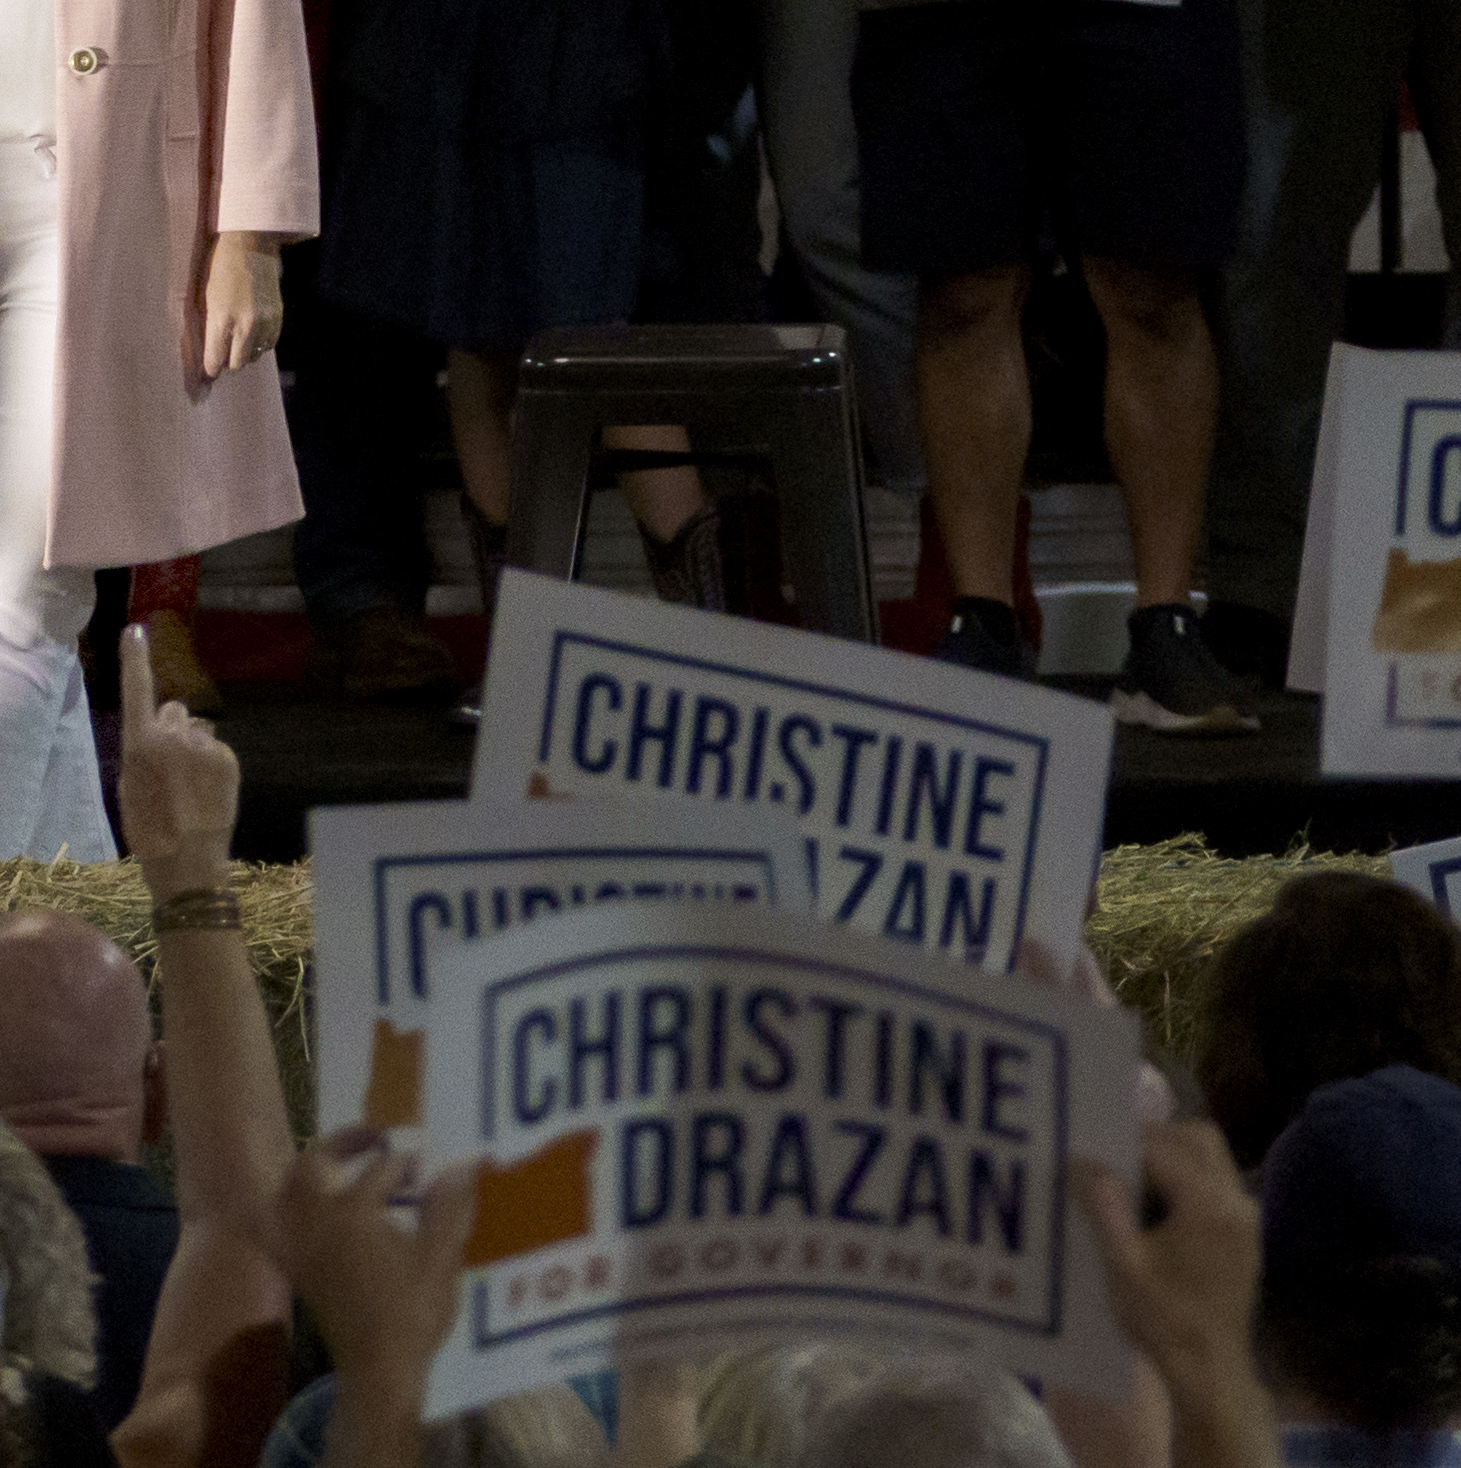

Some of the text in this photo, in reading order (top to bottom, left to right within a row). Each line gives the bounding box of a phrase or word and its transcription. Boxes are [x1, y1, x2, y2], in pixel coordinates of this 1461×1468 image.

[572, 672, 1016, 861] CHRISTINE
[510, 984, 1029, 1144] CHRISTINE
[620, 1110, 1027, 1255] DRAZAN
[507, 1238, 1017, 1308] FOR GOVERNOR
